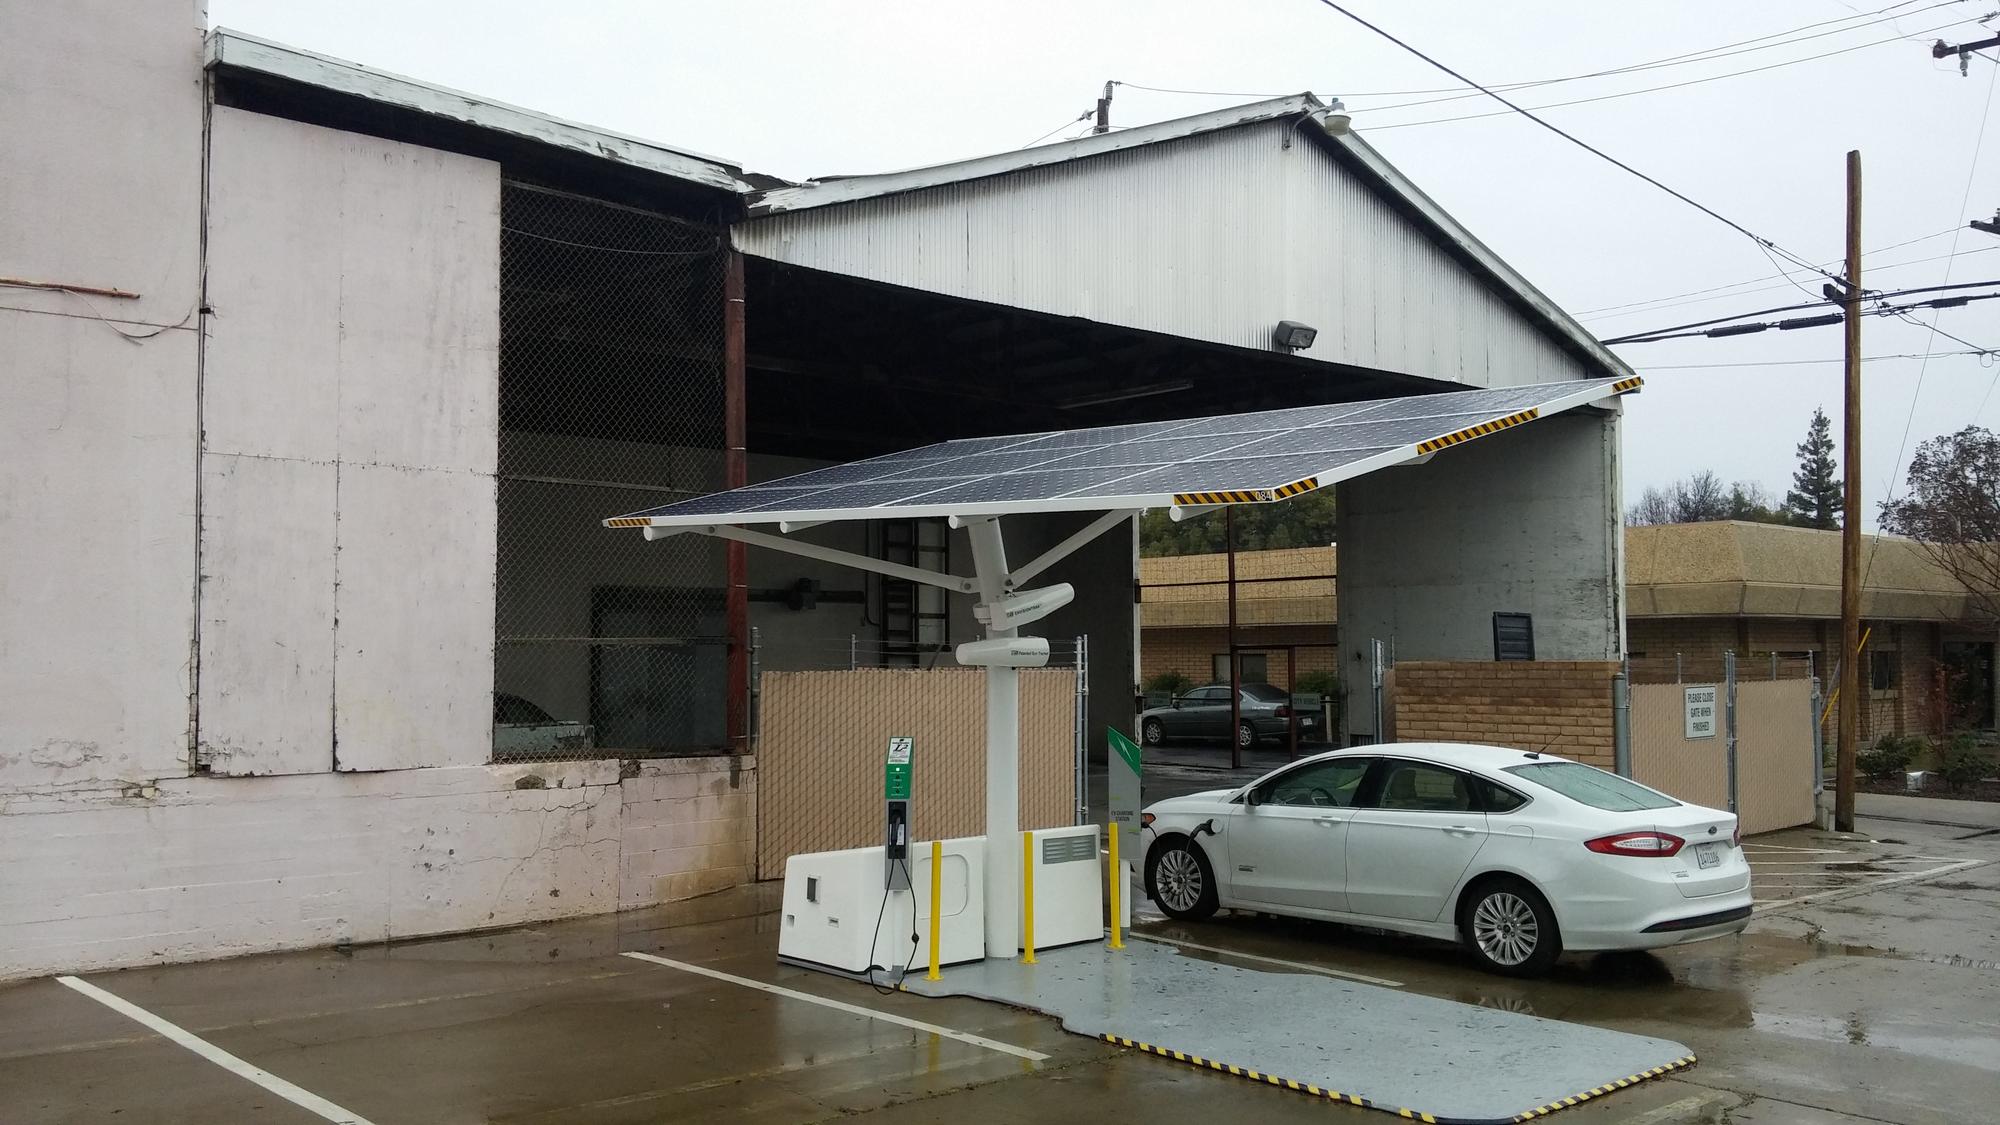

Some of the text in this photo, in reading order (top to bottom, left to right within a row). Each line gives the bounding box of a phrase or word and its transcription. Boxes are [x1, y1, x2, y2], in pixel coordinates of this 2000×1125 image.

[1687, 692, 1714, 703] PLEASE CLOSE
[1690, 707, 1700, 718] GATE
